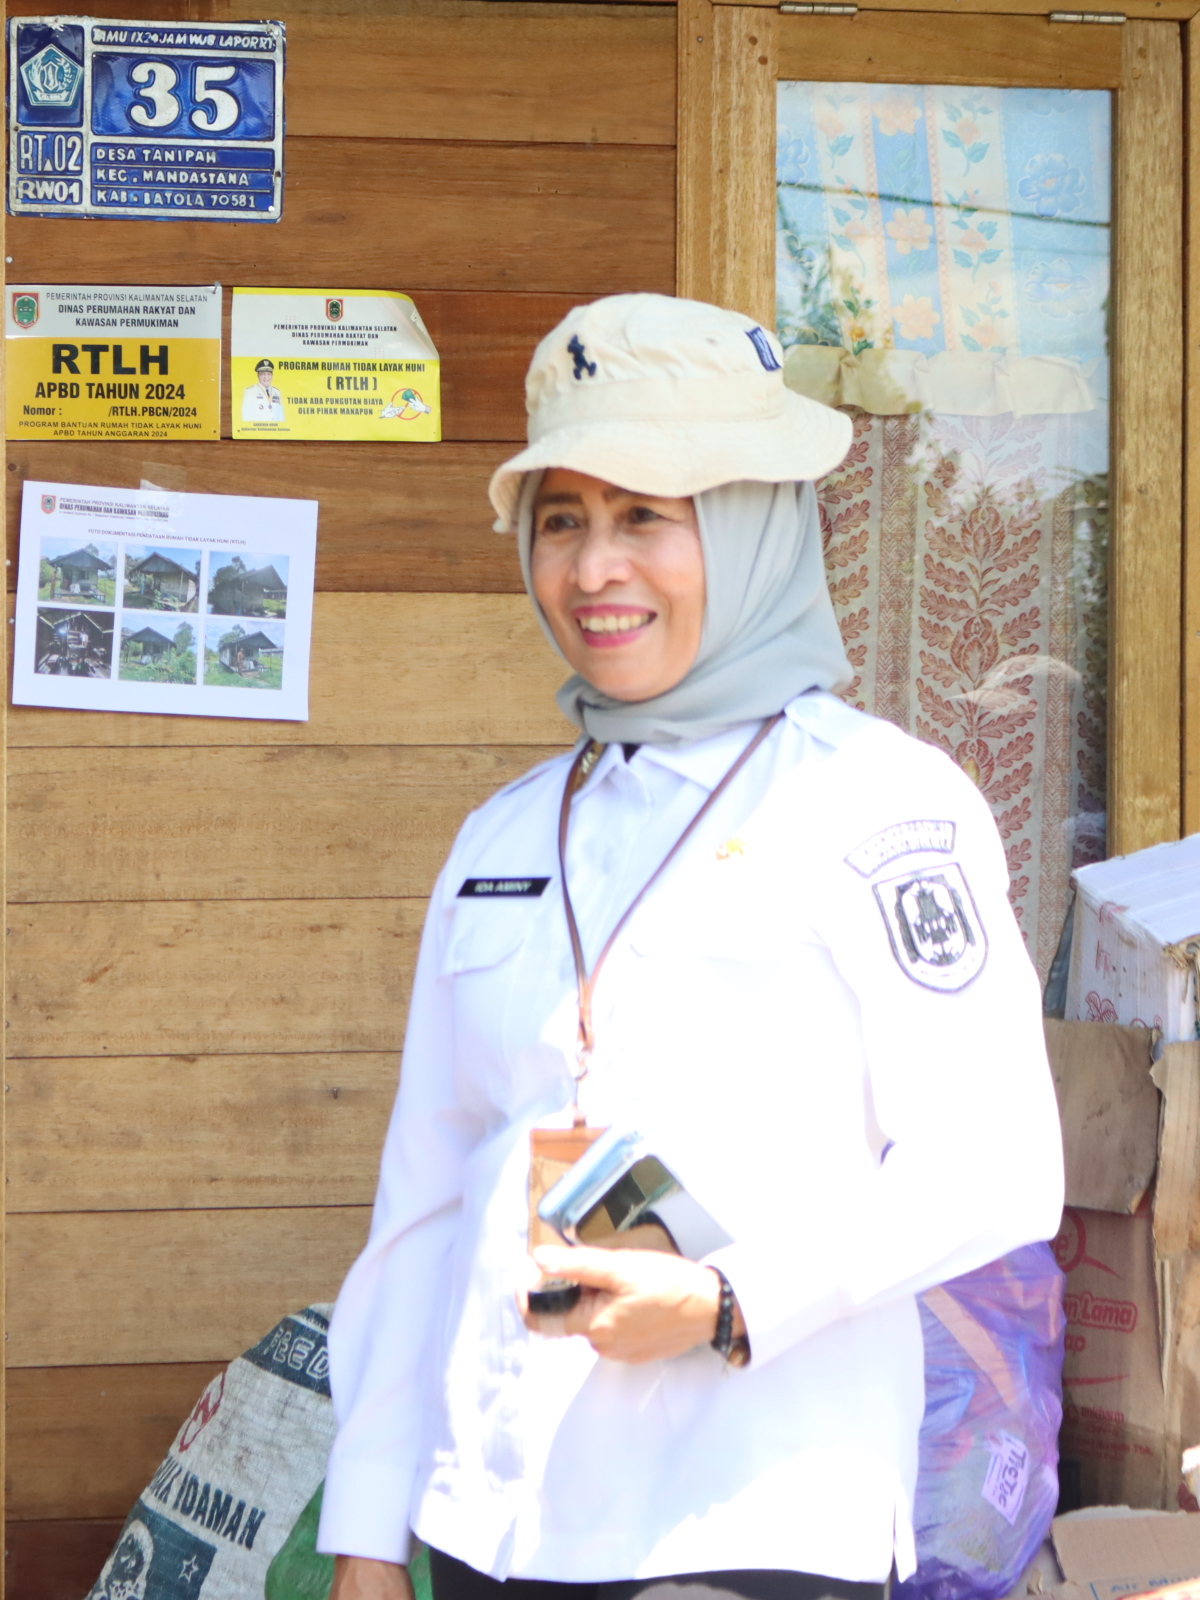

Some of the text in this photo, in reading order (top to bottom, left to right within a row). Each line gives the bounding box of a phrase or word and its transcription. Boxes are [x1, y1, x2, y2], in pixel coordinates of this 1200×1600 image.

[131, 61, 239, 132] 35
[96, 148, 217, 164] DESA TANIPAH
[142, 169, 250, 186] MANDASTANA
[143, 191, 205, 207] BATOLA
[211, 193, 256, 209] 70581
[46, 291, 208, 303] PEMERINTAH PROVINSI KALIMANTAN SELATAN
[58, 304, 196, 316] DINAS PERUMAHAN RAKYAT DAN
[75, 317, 179, 328] KAWASAN PERMUKIMAN
[273, 323, 309, 331] PEMERINTAH
[338, 324, 373, 332] KALIMANTAN
[374, 324, 397, 332] SELATAN
[291, 331, 379, 340] DINAS PERUMAHAN RAKYAT DAN
[302, 339, 369, 347] KAWASAN PERMUKIMAN
[51, 343, 169, 376] RTLH
[278, 361, 425, 373] PROGRAM RUMAH TIDAK LAYAK HUNI
[336, 376, 369, 391] RTLH
[35, 381, 186, 400] APBD TAHUN 2024
[287, 397, 383, 406] TIDAK ADA PUNGUTAN BIAYA
[23, 404, 57, 416] Nomor
[298, 407, 374, 416] OLEH PIHAK MANAPUN
[19, 420, 60, 429] PROGRAM
[60, 421, 99, 429] BANTUAN
[100, 421, 129, 429] RUMAH
[156, 422, 181, 430] LAYAK
[53, 429, 75, 437] APBD
[77, 429, 103, 437] TAHUN
[104, 430, 150, 438] ANGGARAN
[91, 499, 115, 507] PROVINSI
[103, 506, 113, 514] DAN
[101, 529, 136, 537] DOKUMENTASI
[136, 532, 166, 540] PENDATAAN
[1082, 1298, 1133, 1326] Lama
[174, 1469, 267, 1551] IDAMAN
